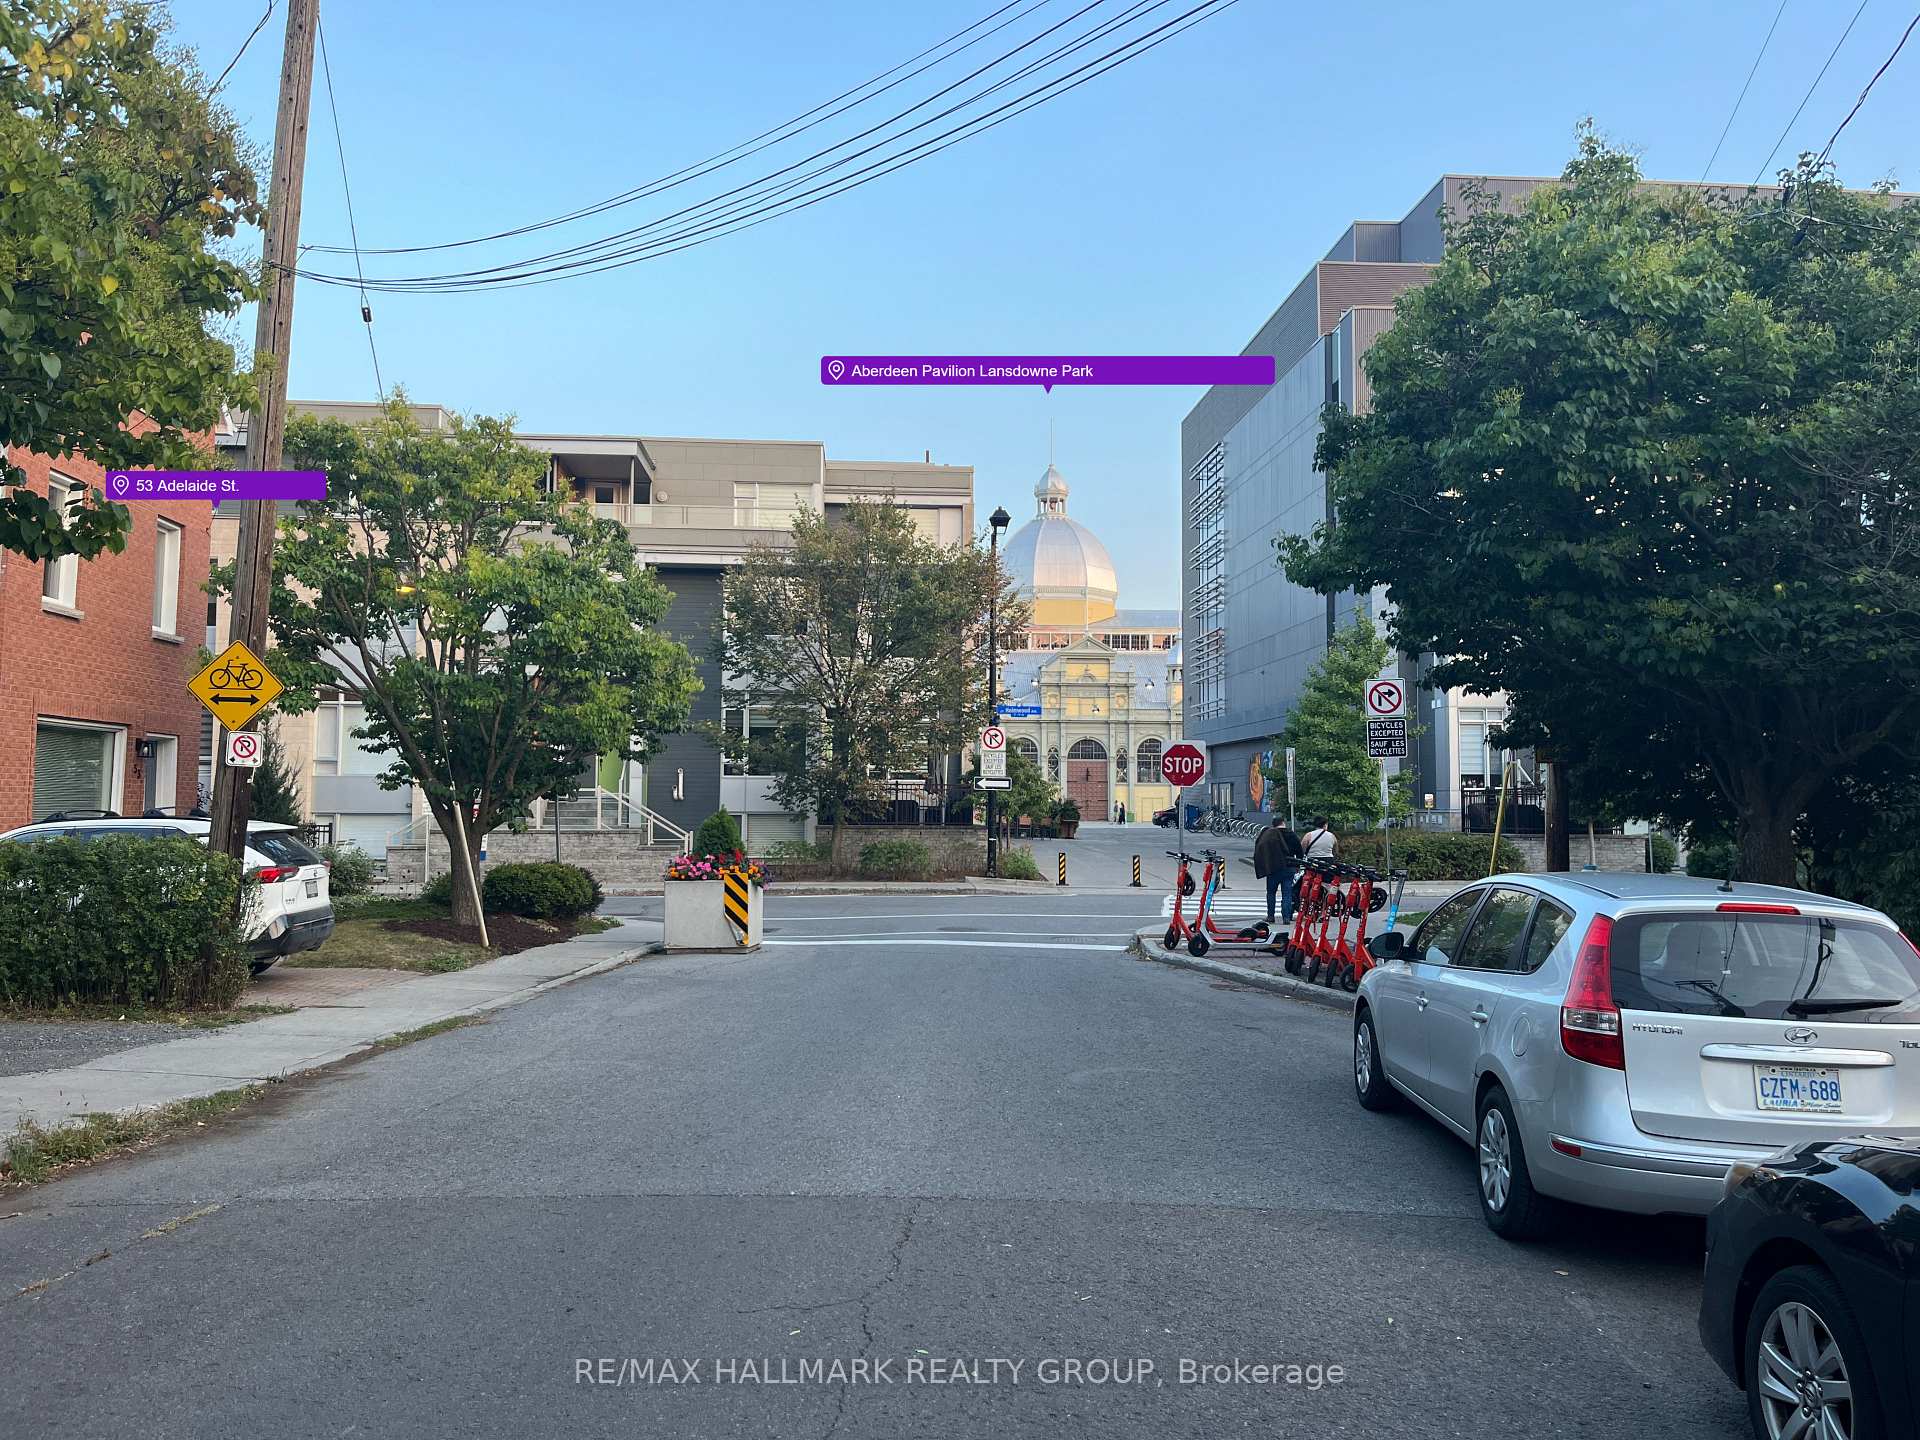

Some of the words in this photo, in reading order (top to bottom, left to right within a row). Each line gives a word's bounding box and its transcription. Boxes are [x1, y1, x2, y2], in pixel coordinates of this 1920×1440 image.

[1370, 721, 1404, 729] BICYCLES
[1370, 740, 1388, 748] SAUF
[1164, 756, 1203, 773] STOP
[1632, 1023, 1683, 1035] HYUNDAI
